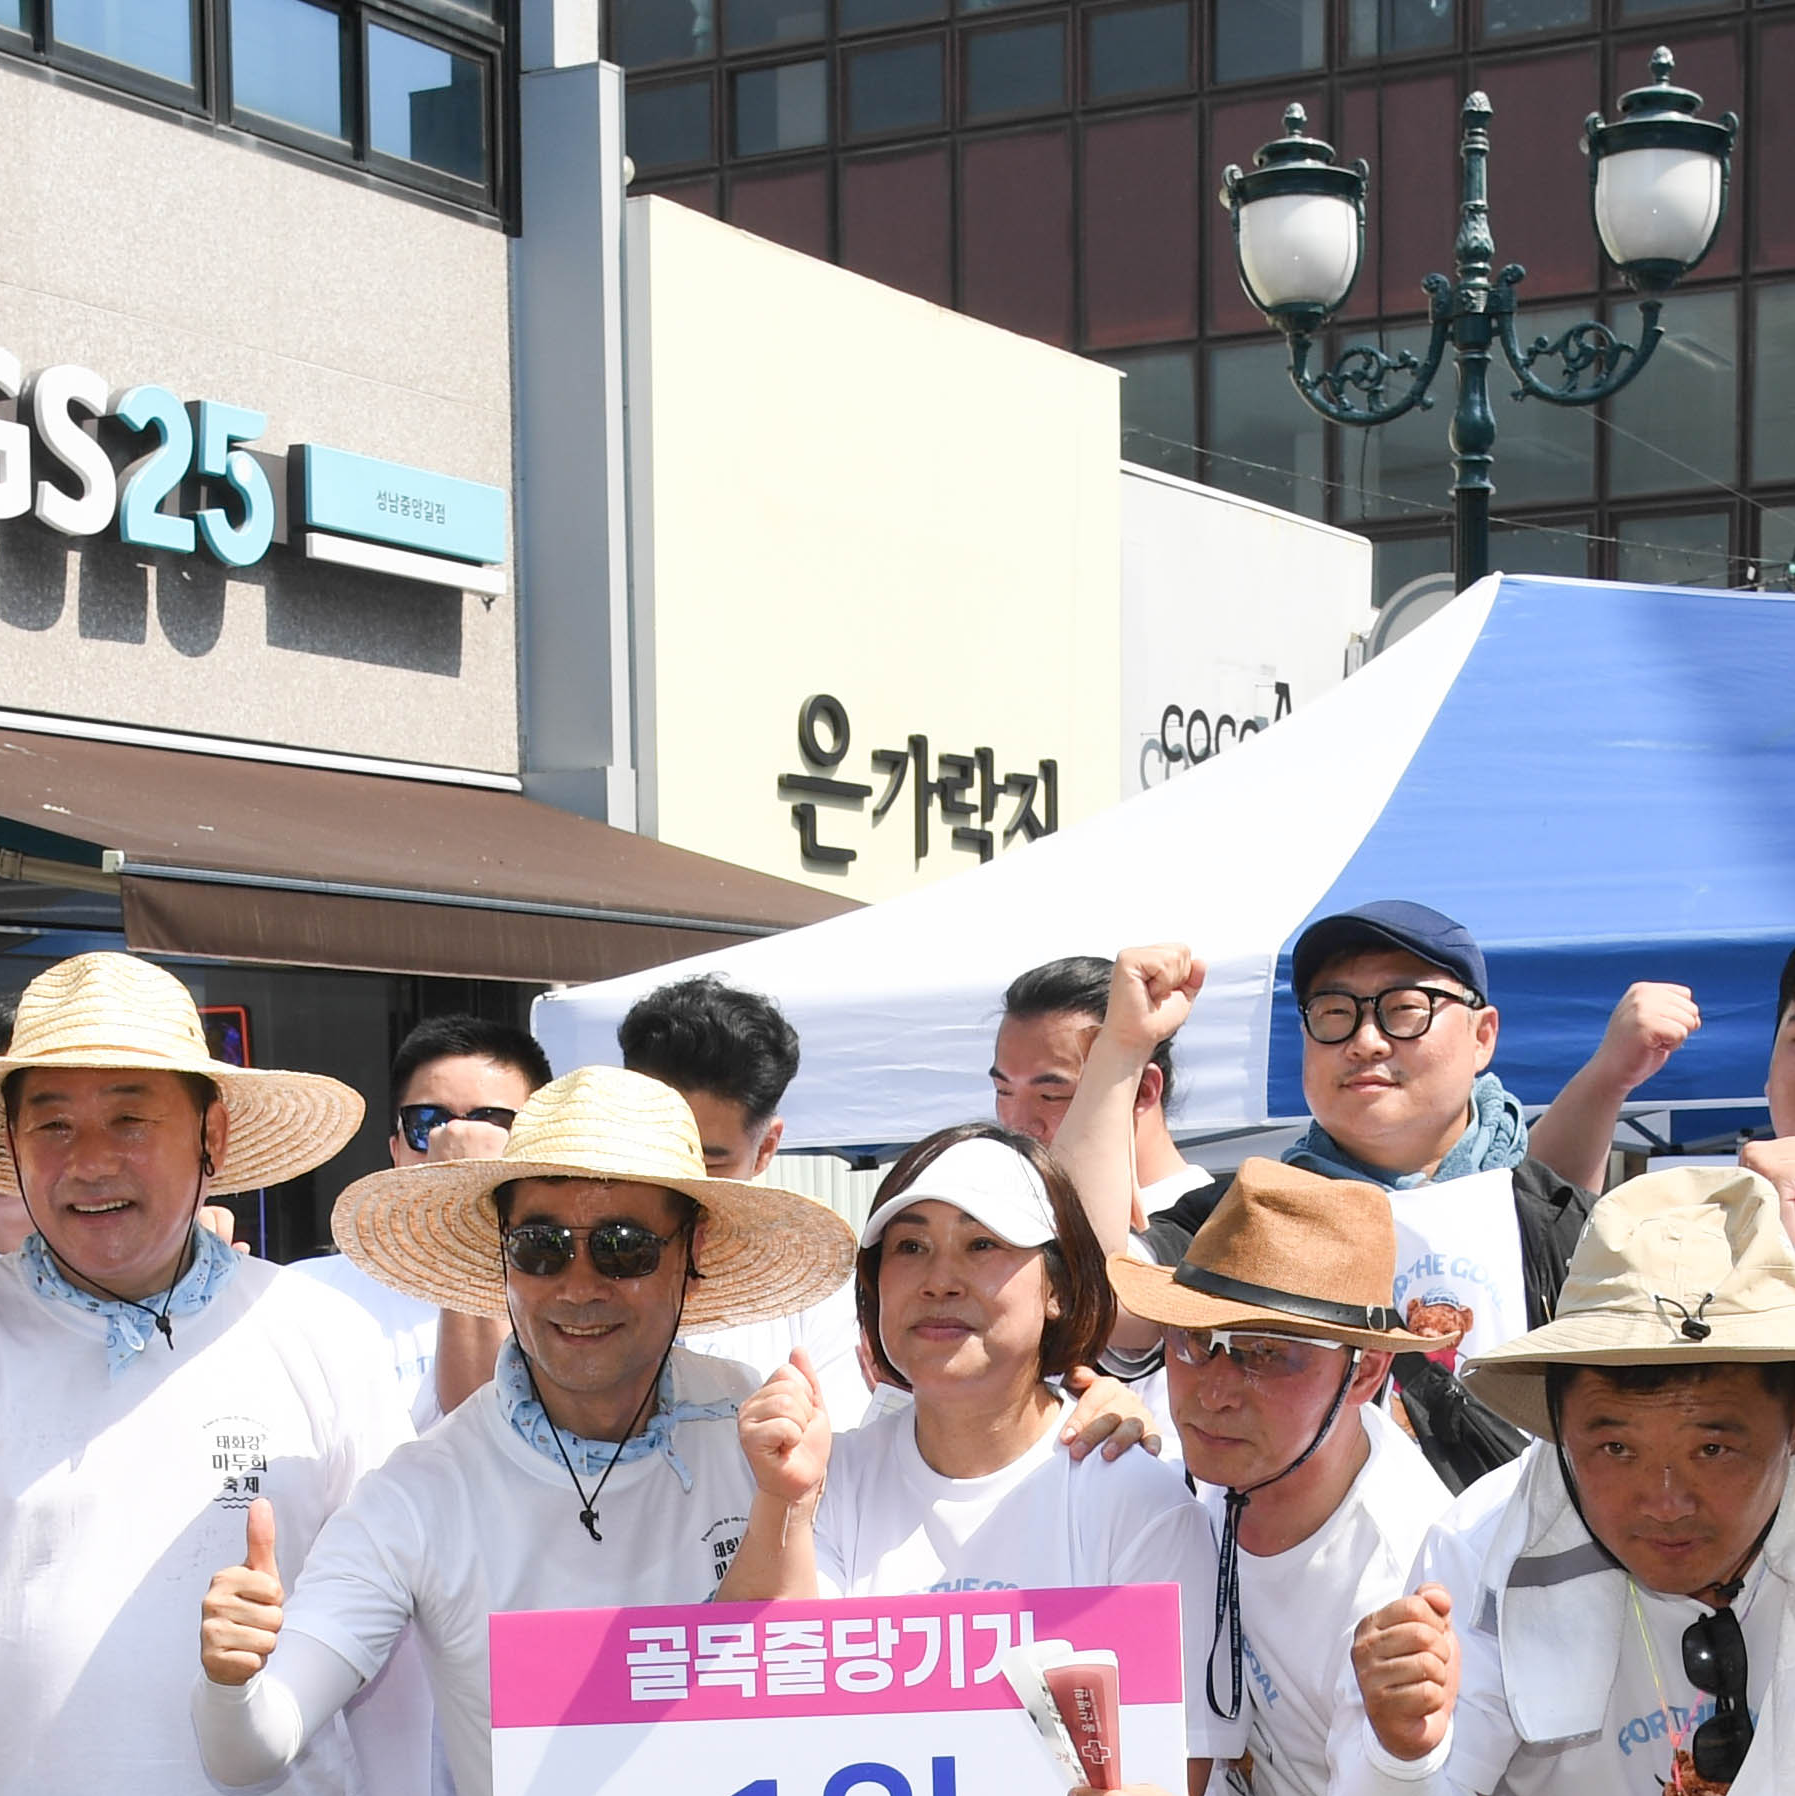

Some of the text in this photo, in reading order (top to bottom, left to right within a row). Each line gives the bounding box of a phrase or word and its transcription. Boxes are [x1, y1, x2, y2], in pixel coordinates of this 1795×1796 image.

[375, 487, 446, 525] 성남중앙길점
[777, 693, 1058, 871] 은가락지
[216, 1434, 260, 1451] 태화강
[212, 1453, 268, 1473] 마두희
[223, 1476, 260, 1494] 축제
[713, 1536, 742, 1558] 태화
[624, 1610, 1036, 1702] 골목줄당기기
[1619, 1708, 1668, 1756] FOR
